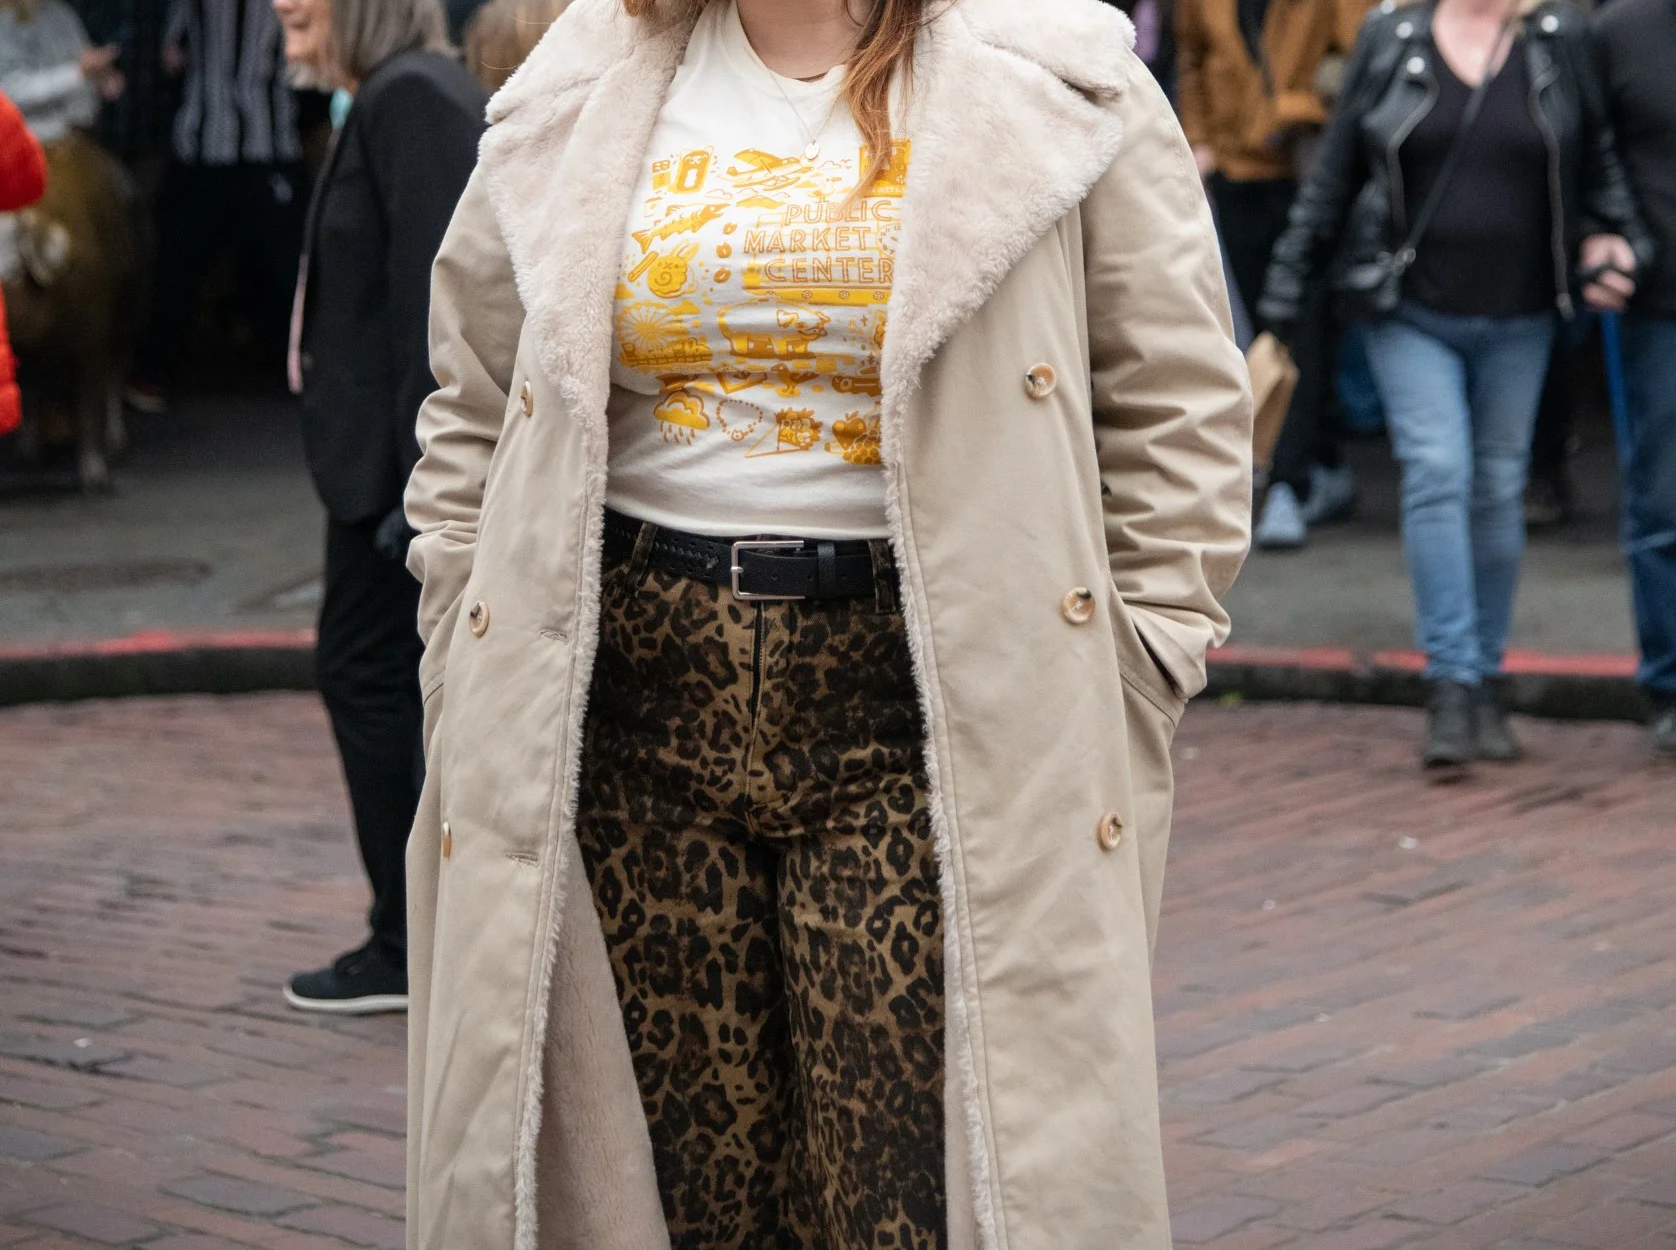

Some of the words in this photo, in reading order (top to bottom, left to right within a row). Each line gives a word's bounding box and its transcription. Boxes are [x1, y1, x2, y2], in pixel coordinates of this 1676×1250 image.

[784, 200, 893, 226] PUBLIC
[743, 226, 871, 254] MARKET
[764, 257, 894, 283] CENTER
